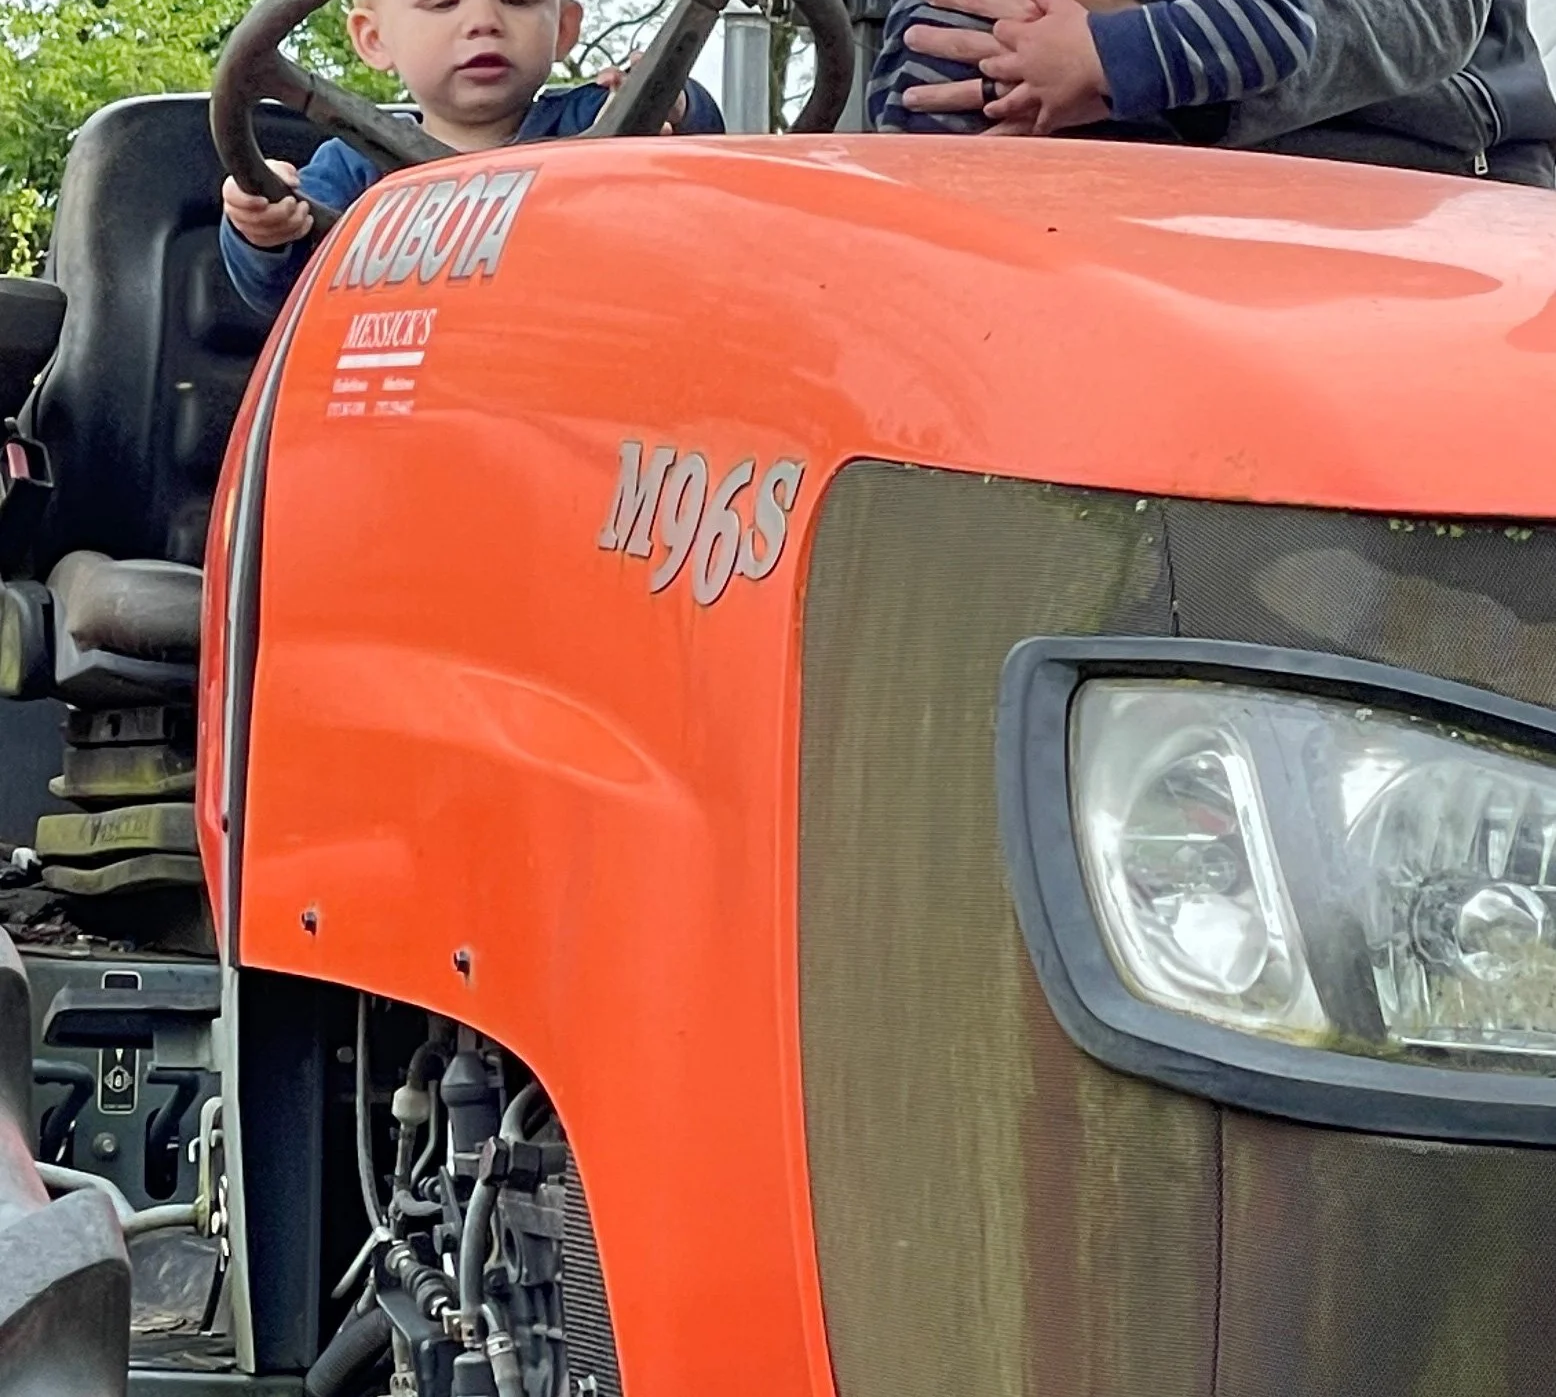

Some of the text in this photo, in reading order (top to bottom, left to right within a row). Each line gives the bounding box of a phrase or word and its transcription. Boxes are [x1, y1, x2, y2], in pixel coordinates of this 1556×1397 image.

[329, 168, 537, 289] KUBOTA
[342, 308, 438, 348] MESSICK'S
[598, 441, 806, 606] M96S
